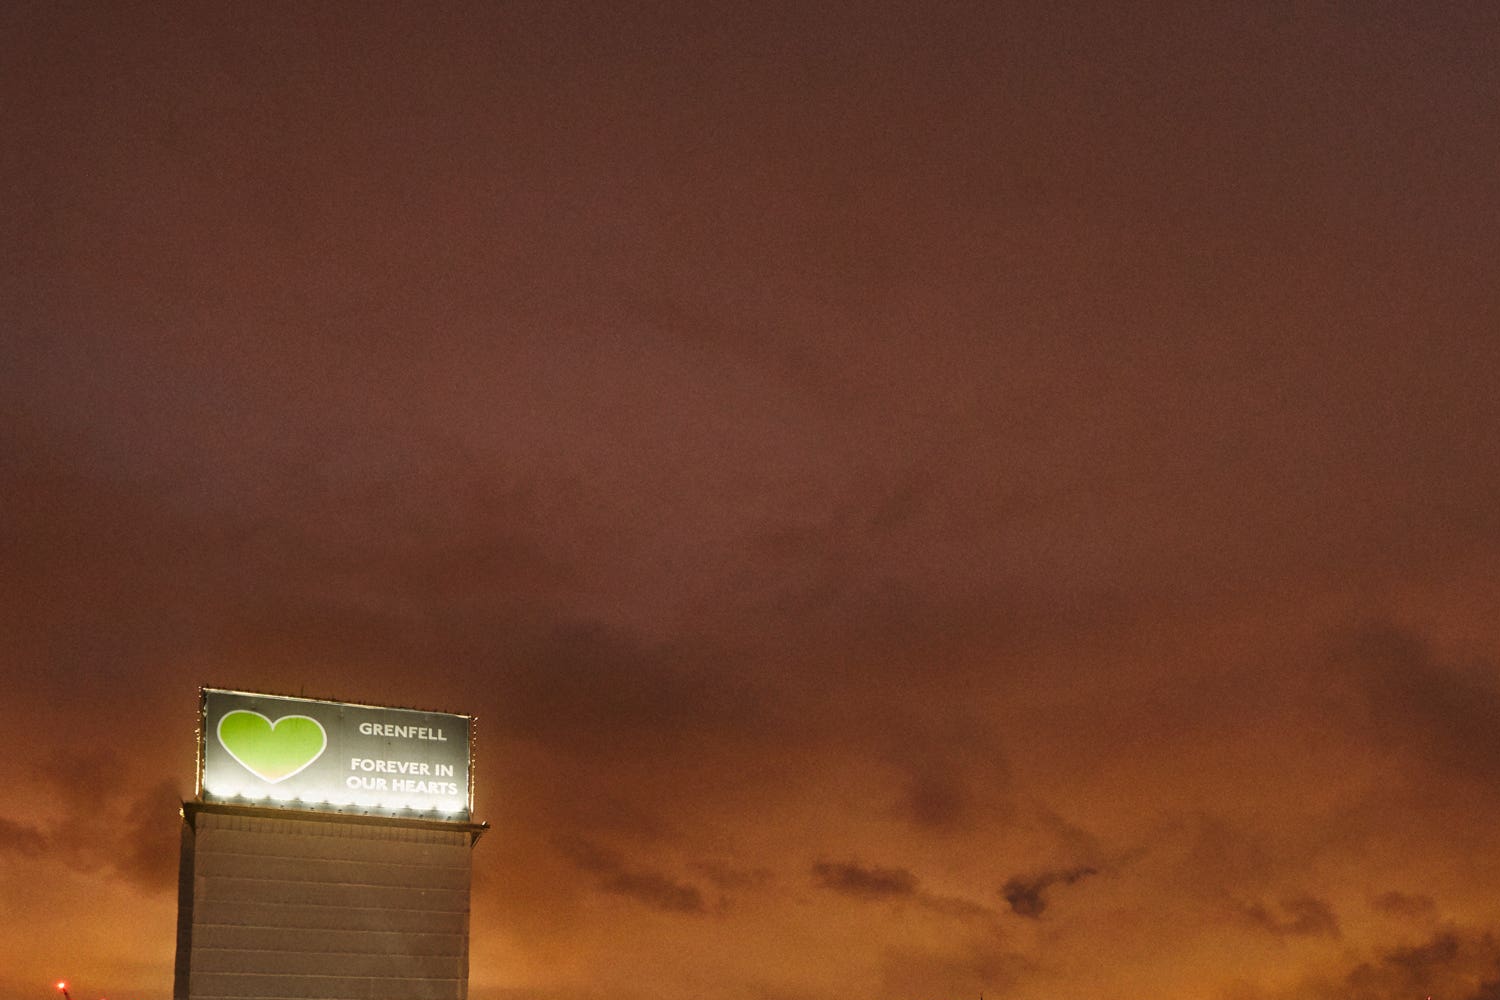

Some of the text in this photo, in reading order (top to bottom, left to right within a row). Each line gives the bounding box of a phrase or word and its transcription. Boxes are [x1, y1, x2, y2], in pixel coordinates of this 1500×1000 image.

[359, 722, 447, 741] GRENFELL
[351, 757, 454, 777] FOREVER IN
[346, 775, 458, 795] OUR HEARTS
